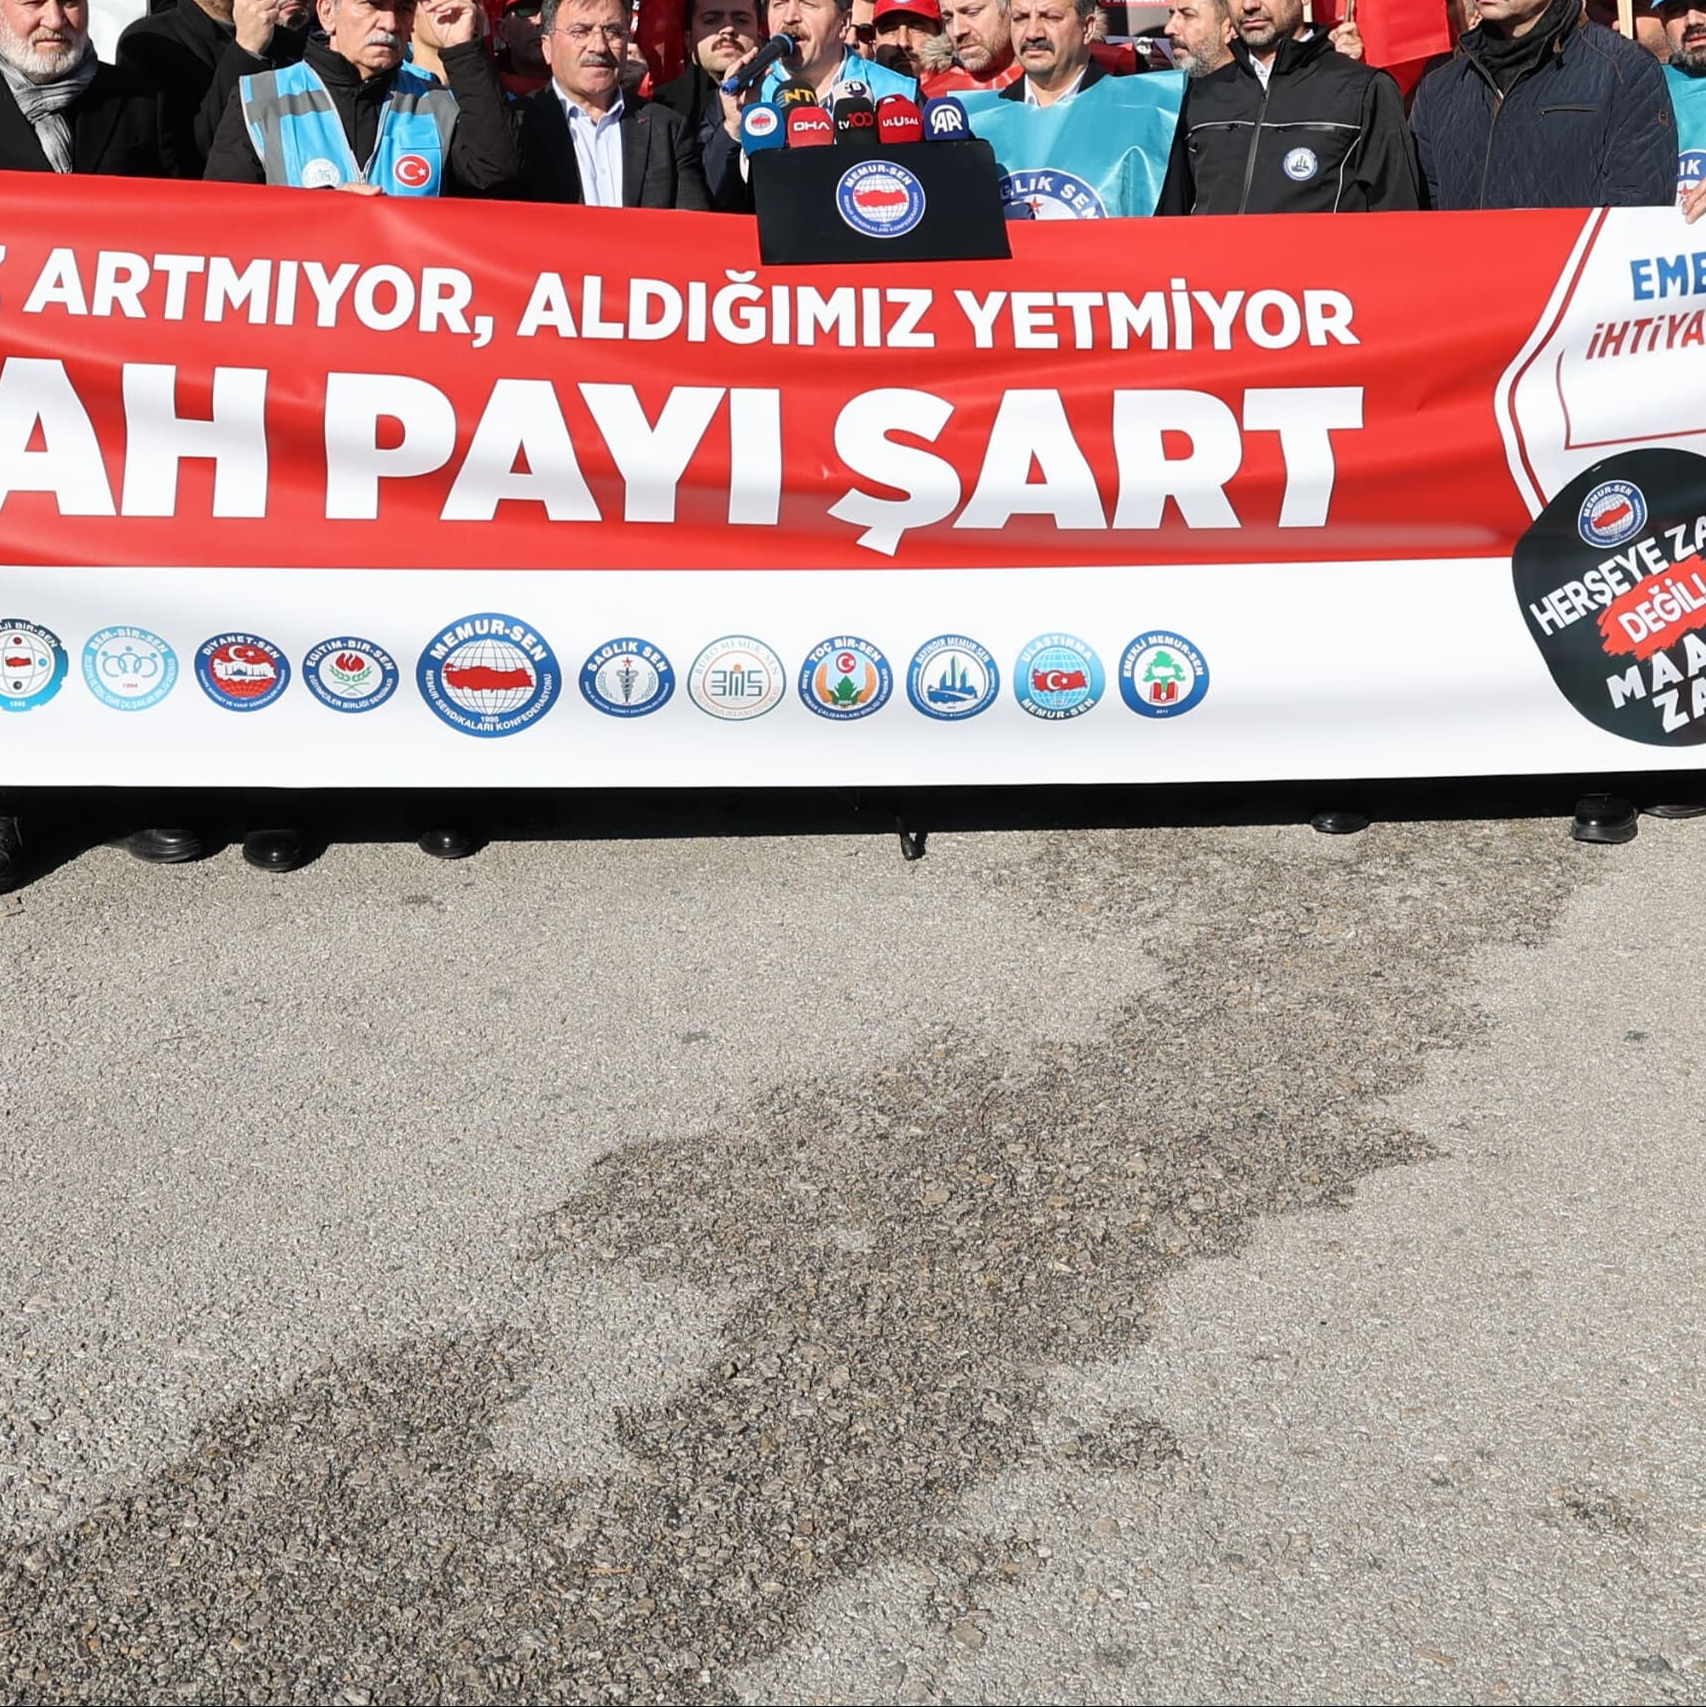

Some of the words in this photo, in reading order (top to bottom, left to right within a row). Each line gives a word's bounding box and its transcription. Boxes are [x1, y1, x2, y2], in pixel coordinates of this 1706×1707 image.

[883, 116, 919, 127] ULUSAL
[934, 111, 963, 134] AA
[21, 248, 494, 349] ARTMIYOR,
[516, 268, 937, 349] ALDIĞIMIZ
[951, 278, 1361, 352] YETMİYOR
[323, 371, 781, 526] PAYI
[826, 386, 1365, 557] ŞART
[1530, 538, 1669, 637] HERŞEYE
[429, 618, 547, 663] MEMUR-SEN
[808, 640, 831, 663] TOÇ
[834, 635, 883, 662] BİR-SEN
[1021, 697, 1097, 719] MEMUR-SEN
